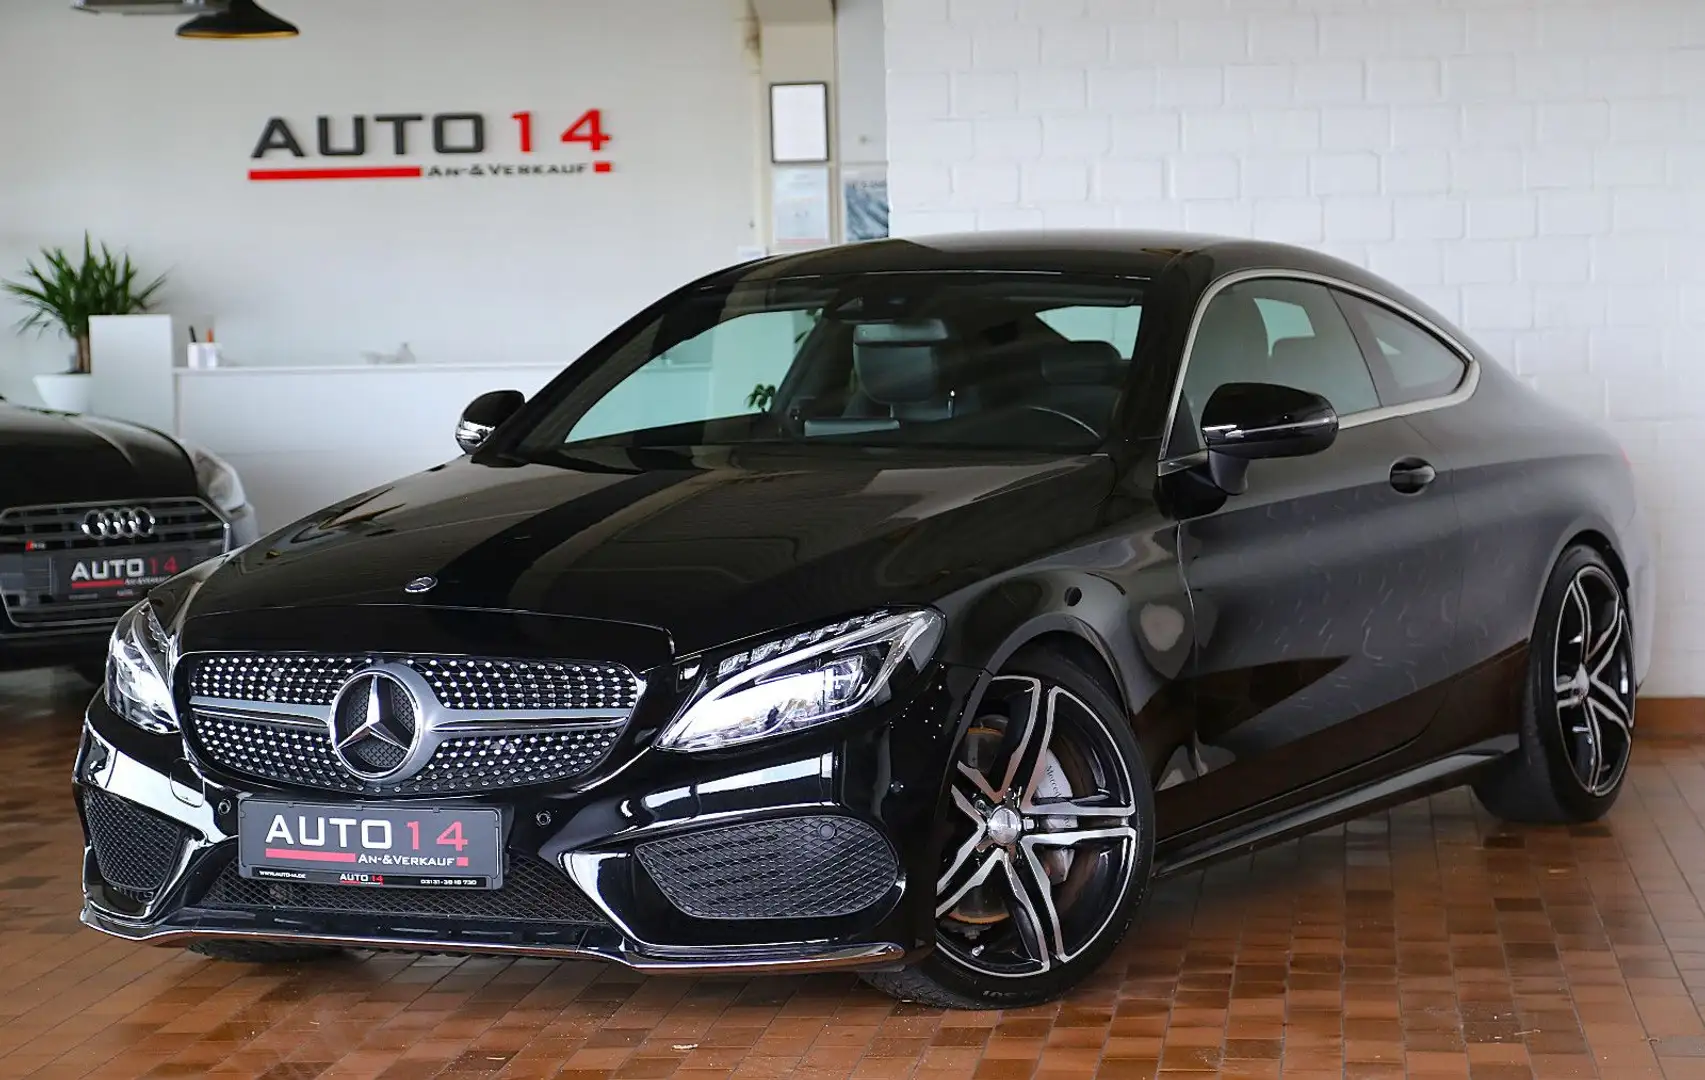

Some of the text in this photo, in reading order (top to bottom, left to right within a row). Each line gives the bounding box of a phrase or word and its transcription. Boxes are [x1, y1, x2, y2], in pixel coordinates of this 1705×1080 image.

[251, 108, 612, 158] AUTO 14
[71, 556, 179, 581] AUTO 14
[265, 814, 469, 852] AUTO 14
[340, 873, 369, 882] AUTO
[371, 874, 384, 883] 14
